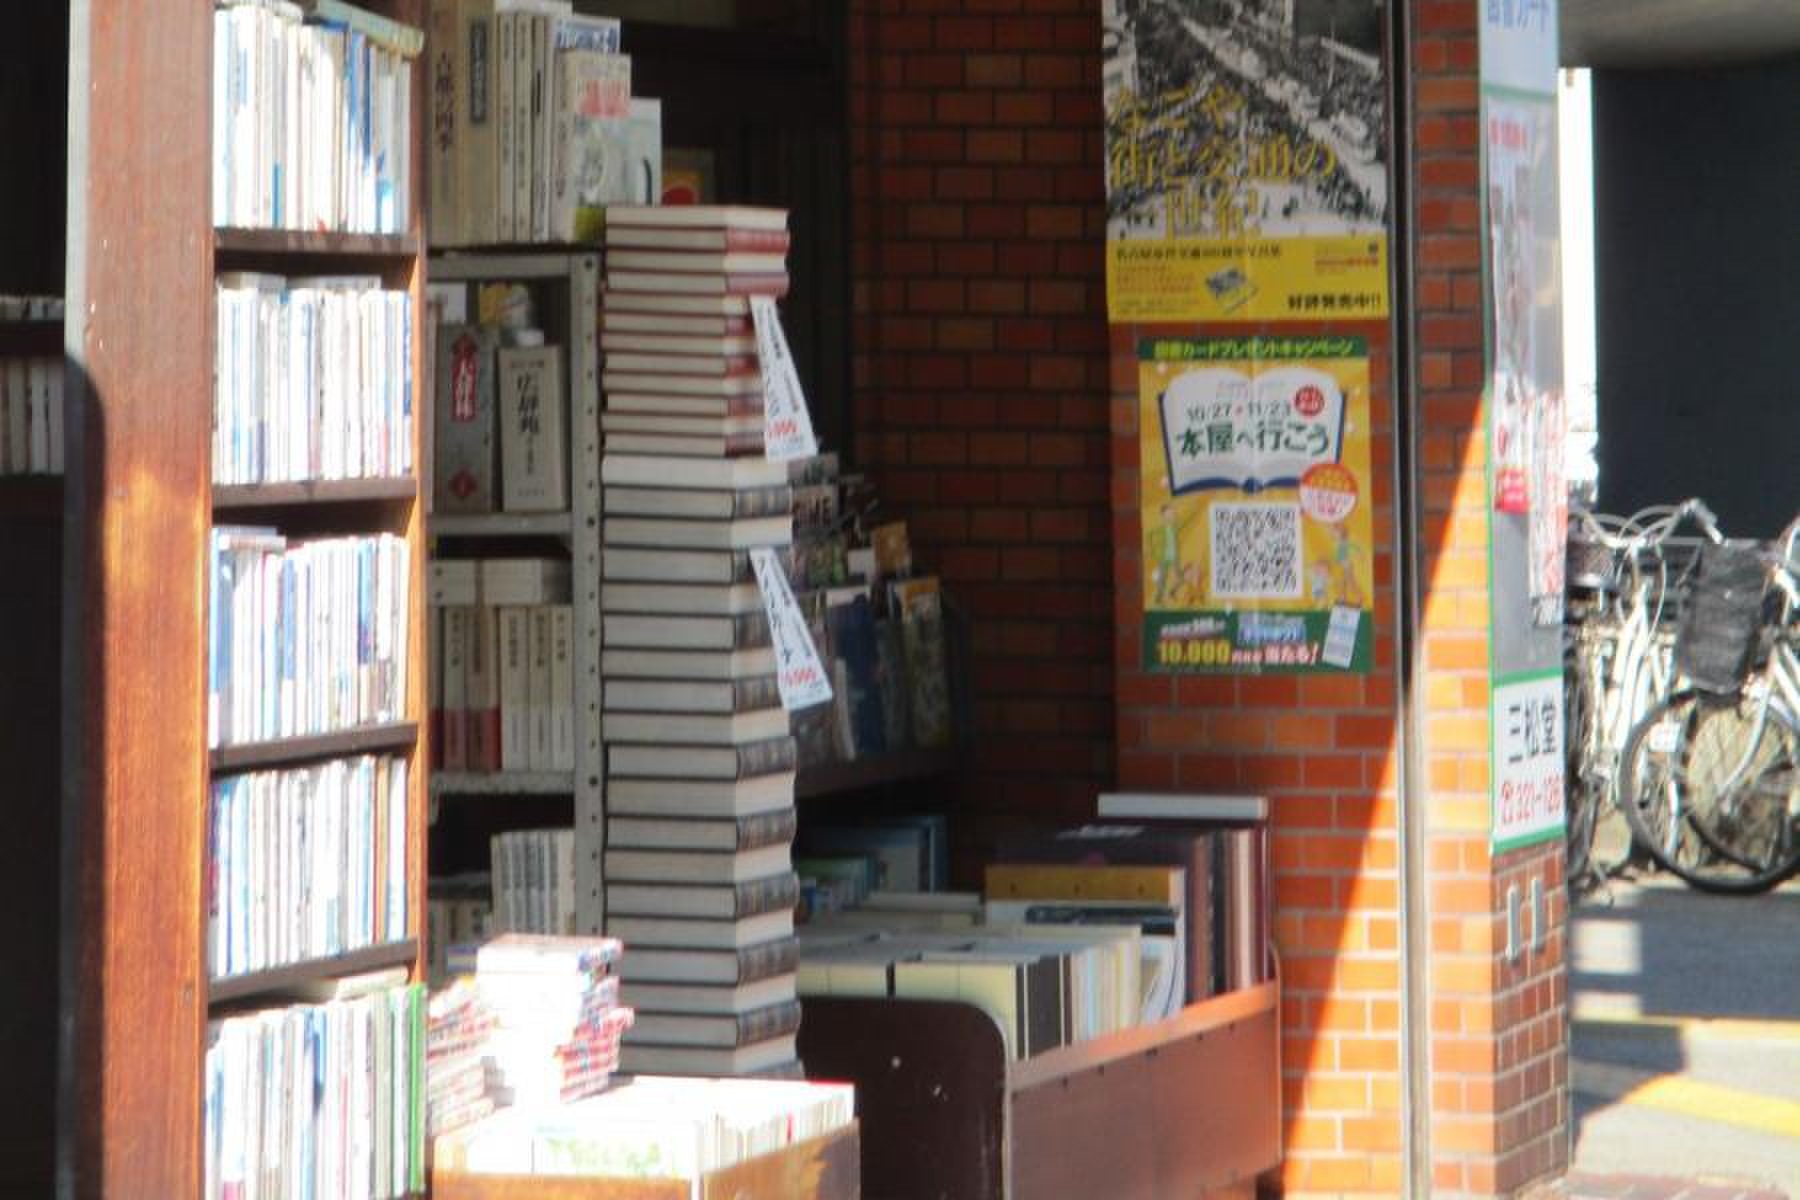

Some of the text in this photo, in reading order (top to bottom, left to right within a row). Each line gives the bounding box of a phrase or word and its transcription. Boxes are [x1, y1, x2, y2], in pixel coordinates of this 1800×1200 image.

[1174, 420, 1331, 457] 本屋へ行こう
